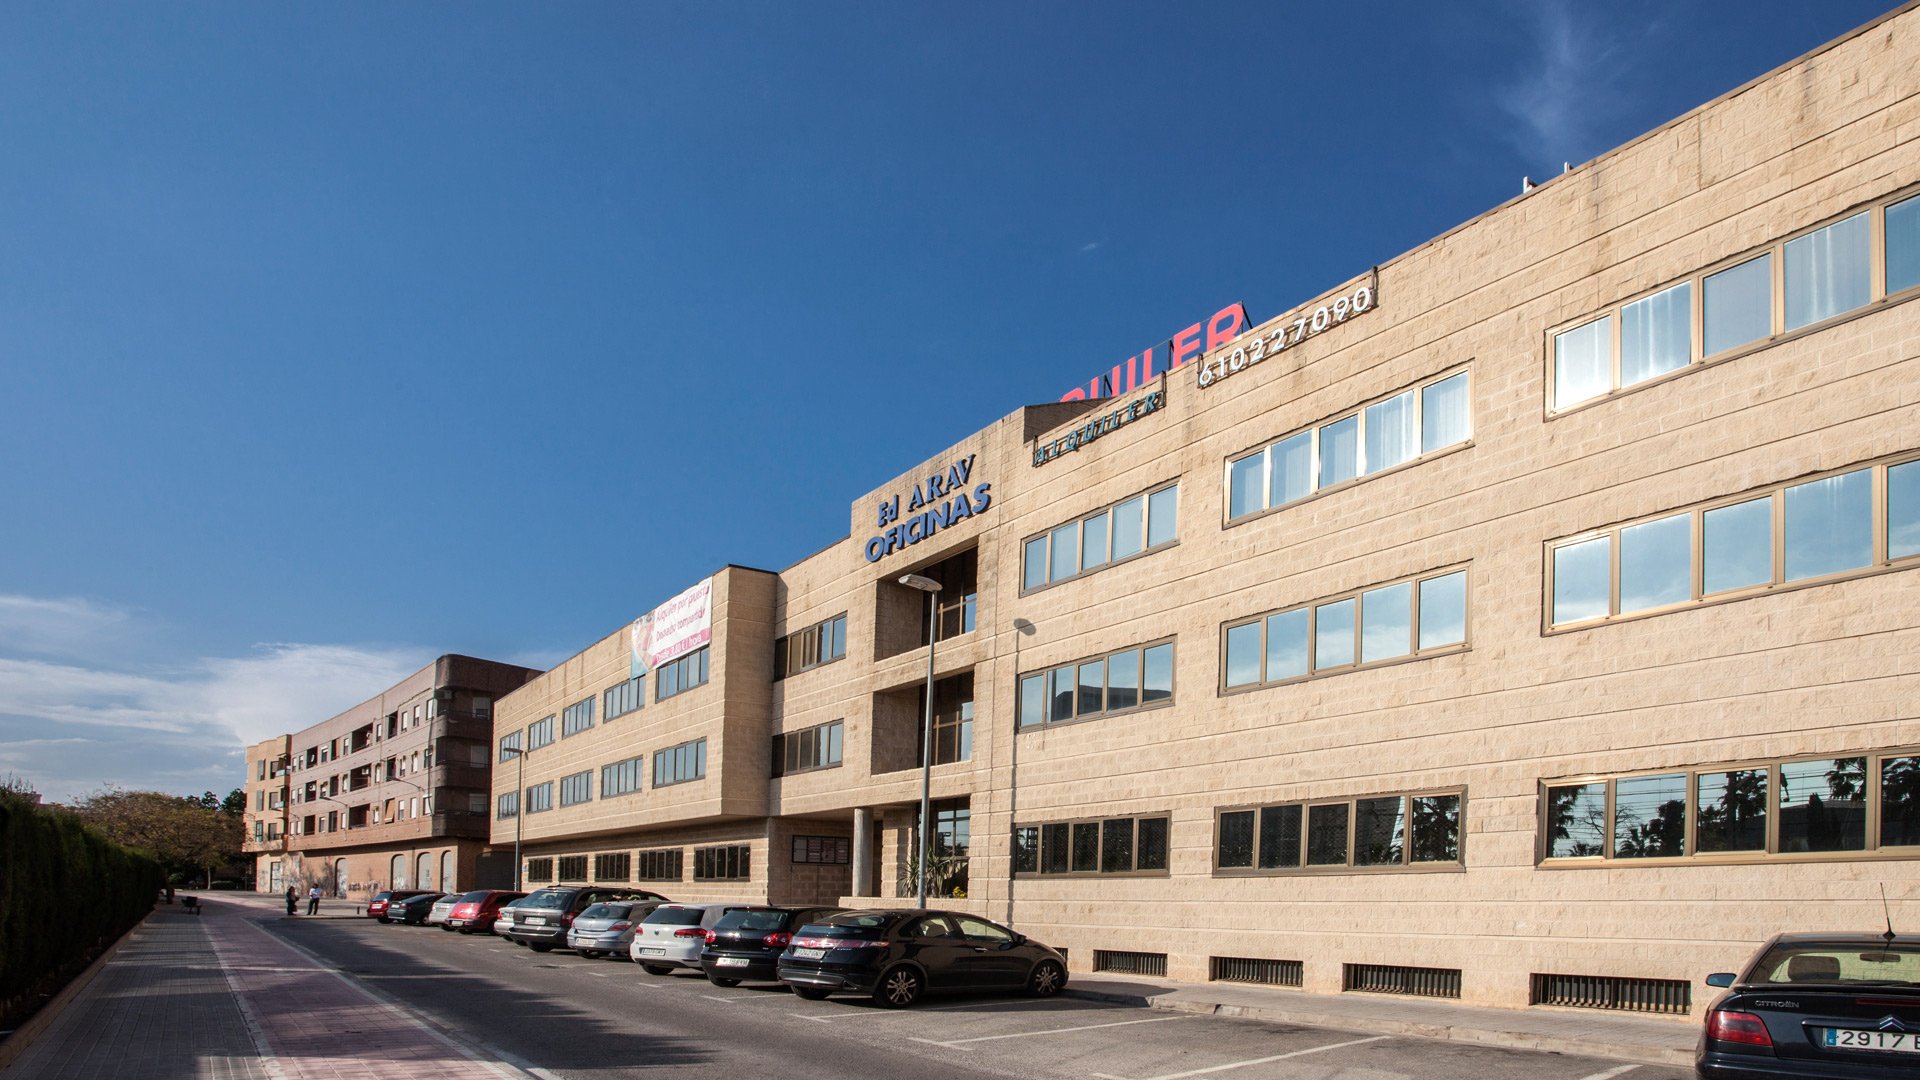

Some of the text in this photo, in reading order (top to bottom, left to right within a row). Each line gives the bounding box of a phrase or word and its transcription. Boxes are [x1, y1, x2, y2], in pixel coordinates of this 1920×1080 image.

[1033, 391, 1158, 465] ALQUILER
[864, 482, 992, 563] OFICINAS
[877, 453, 976, 527] Ed ARAV
[1755, 1000, 1800, 1008] CITROËN
[1841, 1030, 1905, 1048] 2917
